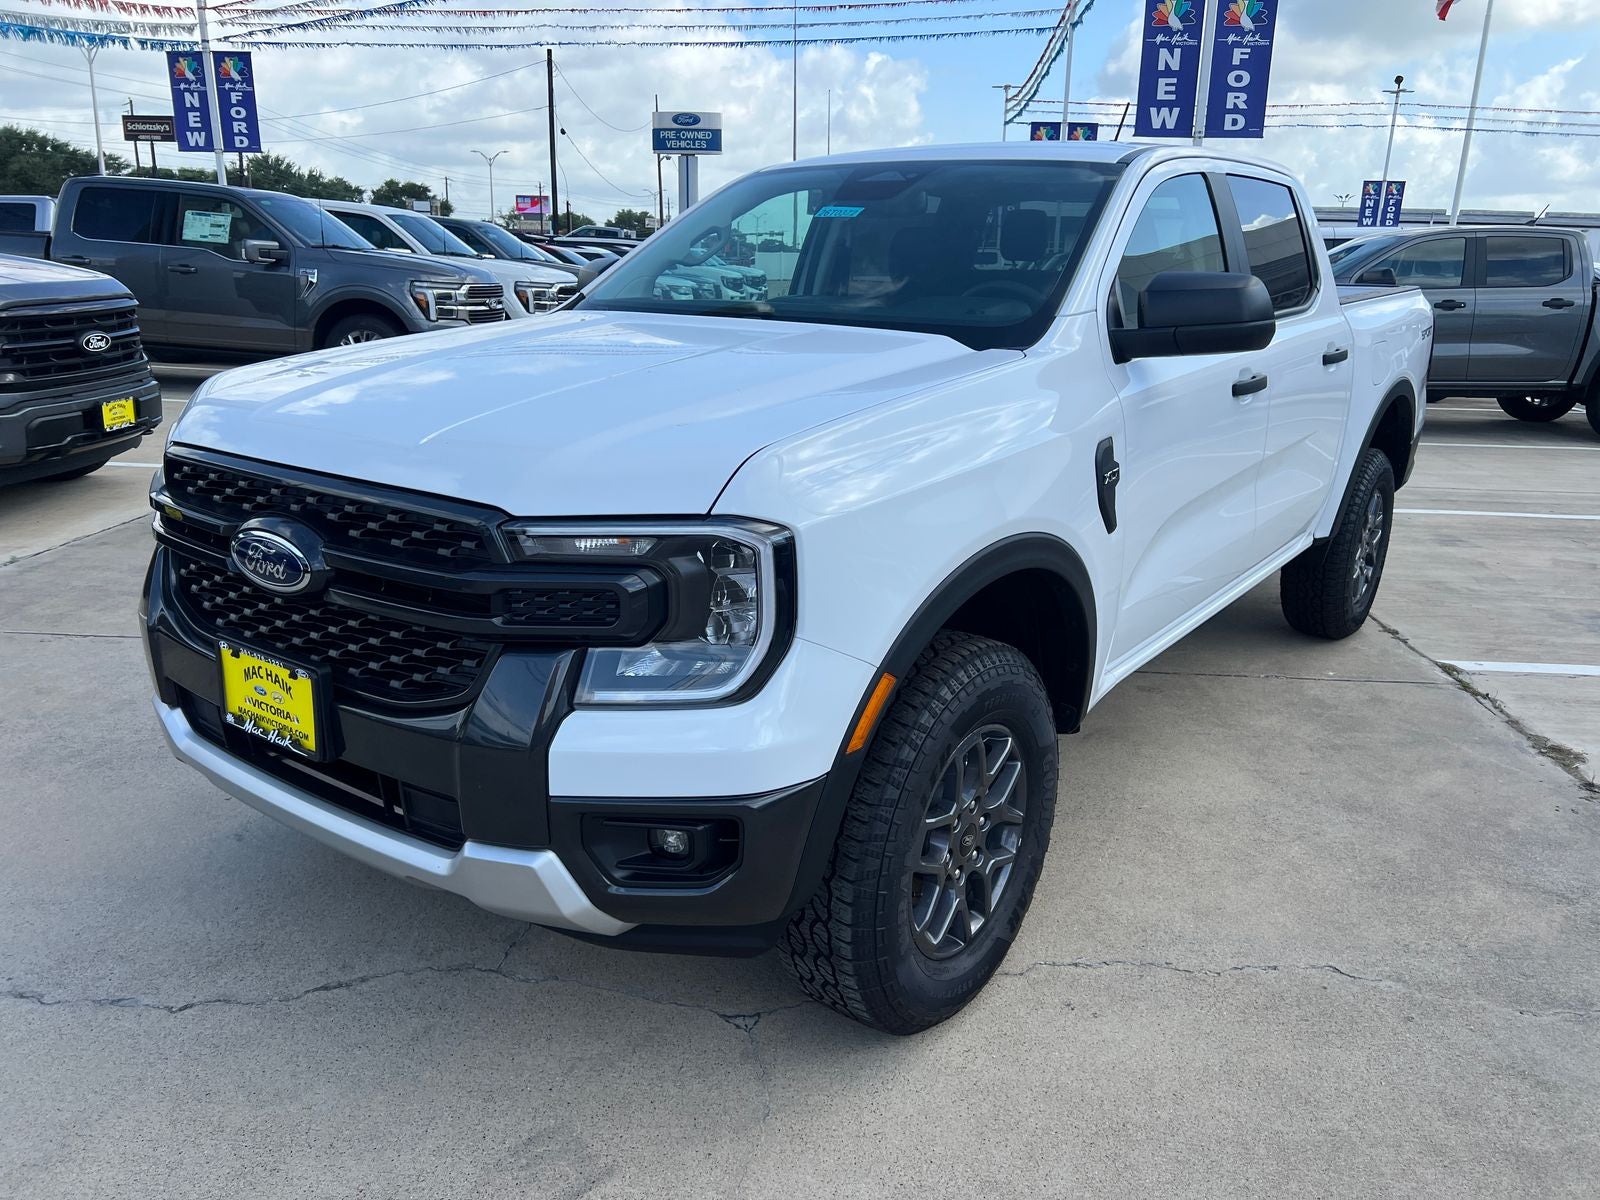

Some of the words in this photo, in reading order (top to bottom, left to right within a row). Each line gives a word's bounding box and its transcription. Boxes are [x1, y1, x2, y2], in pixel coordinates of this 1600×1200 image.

[1149, 48, 1181, 129] NEW
[1223, 48, 1251, 131] FORD
[127, 122, 170, 132] Schlotzsky's
[184, 92, 205, 147] NEW
[230, 92, 249, 148] FORD
[665, 140, 707, 149] VEHICLES
[1362, 199, 1374, 226] NEW
[1385, 199, 1396, 226] FORD
[89, 336, 106, 349] Ford
[245, 542, 288, 580] Ford
[243, 666, 264, 682] MAC
[265, 667, 294, 700] HAIK
[238, 705, 310, 742] MACHAIKVICTORIA.COM
[249, 696, 294, 723] VICTORIA
[243, 718, 266, 736] Mac
